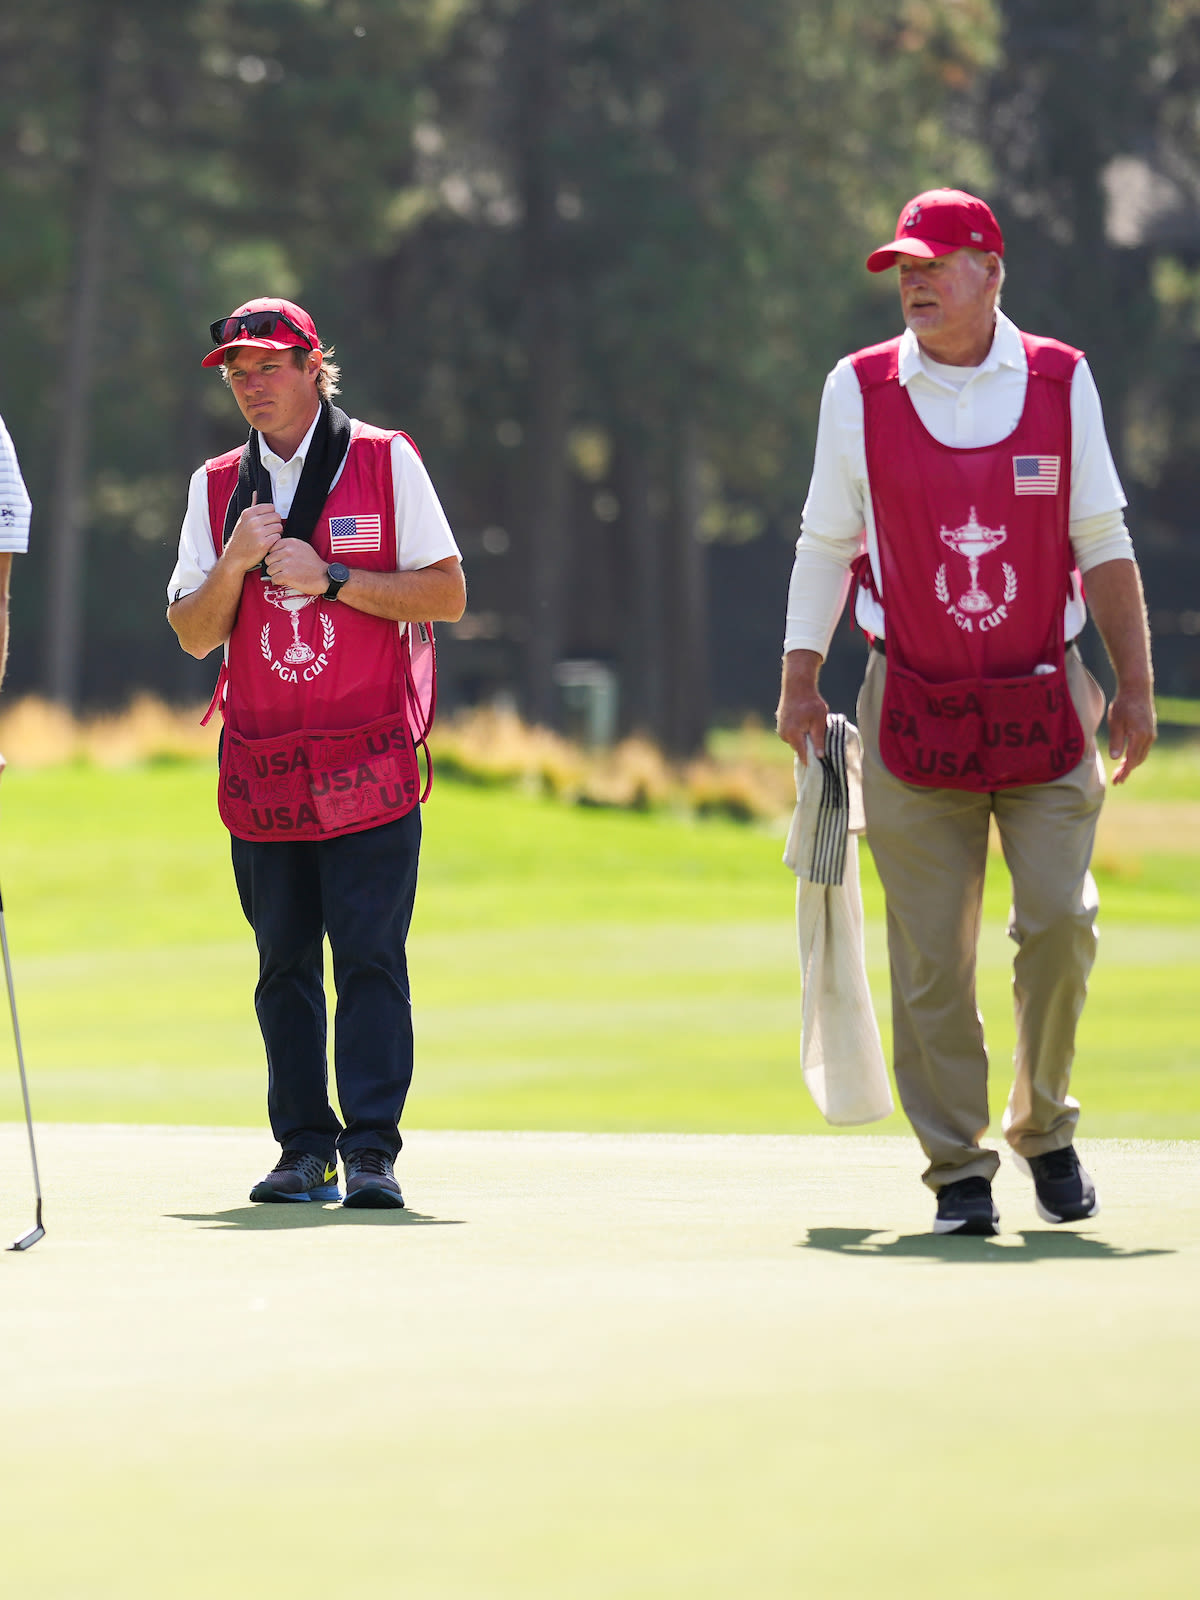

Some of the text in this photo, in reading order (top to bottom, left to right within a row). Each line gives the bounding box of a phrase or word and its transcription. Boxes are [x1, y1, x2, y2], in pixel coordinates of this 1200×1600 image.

[979, 604, 1008, 632] CUP
[270, 652, 329, 683] PGA CUP
[927, 692, 984, 720] USA
[982, 720, 1051, 748] USA
[252, 746, 310, 778] USA
[915, 747, 985, 777] USA
[309, 762, 379, 796] USA
[252, 804, 320, 831] USA
